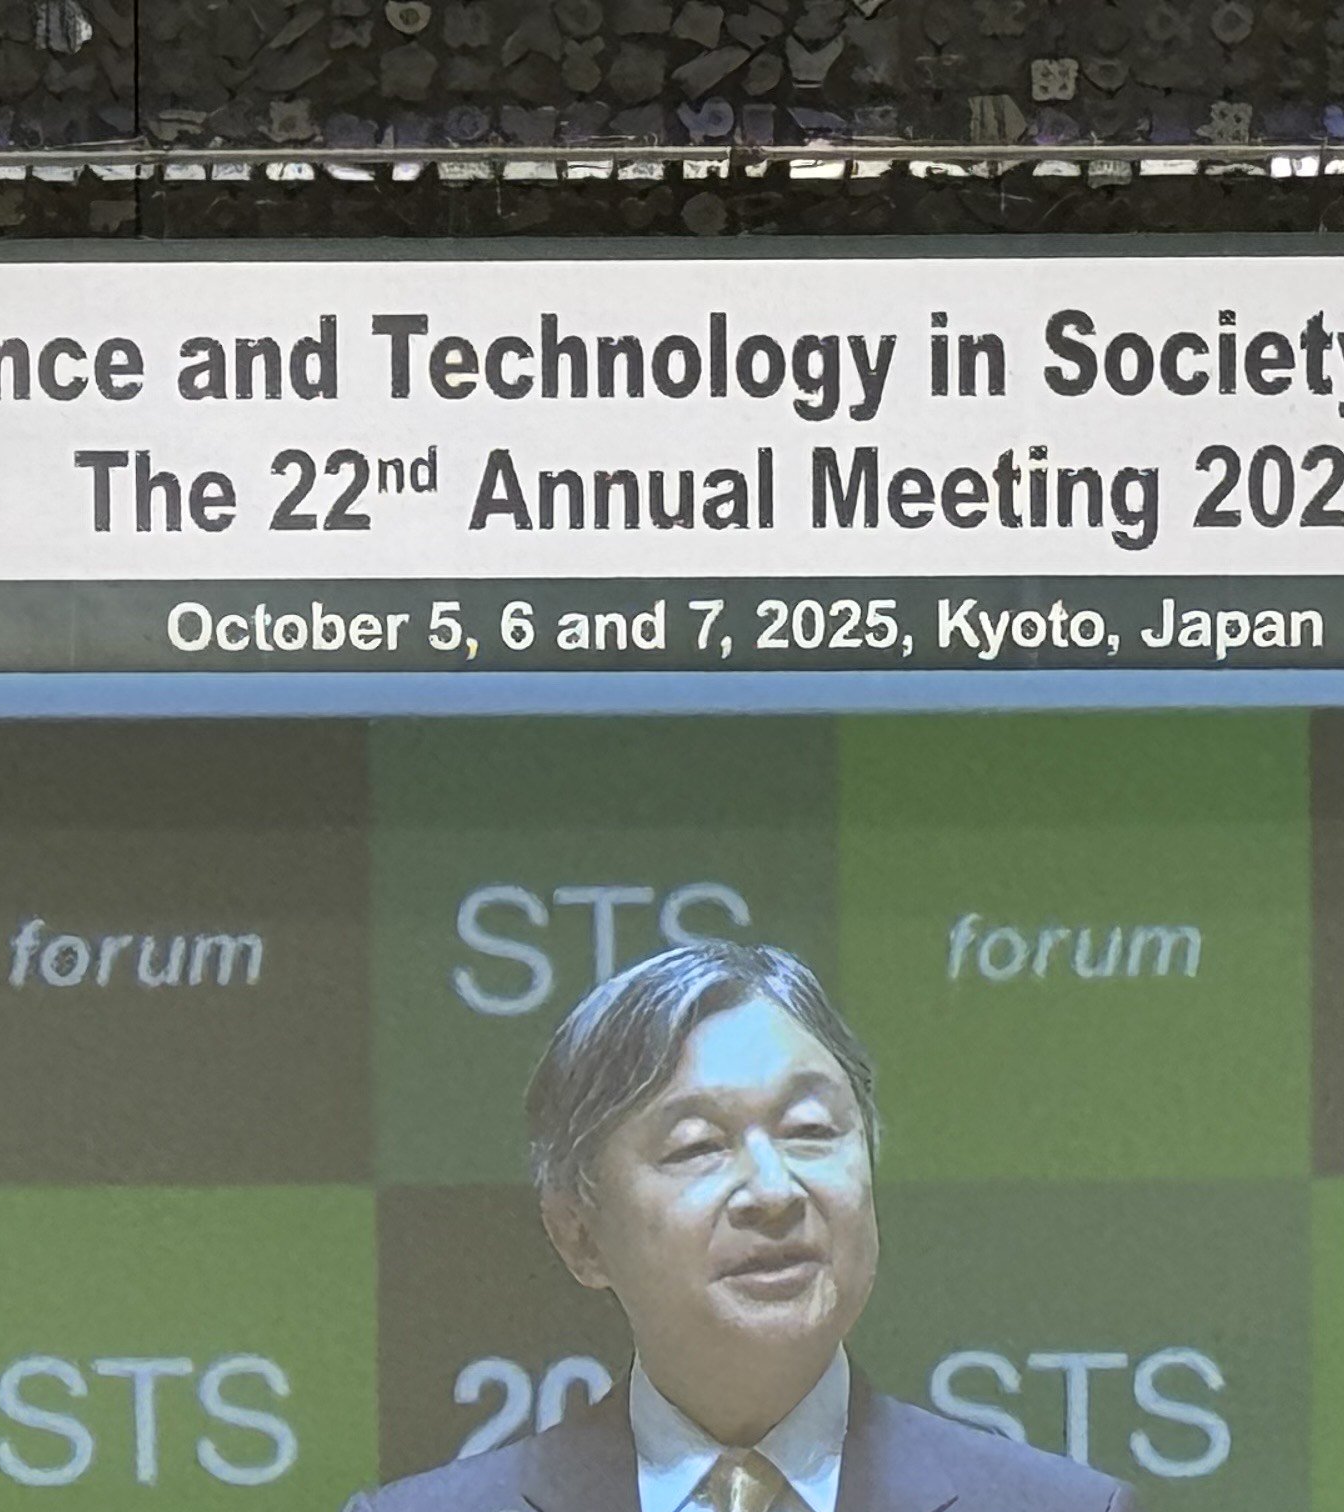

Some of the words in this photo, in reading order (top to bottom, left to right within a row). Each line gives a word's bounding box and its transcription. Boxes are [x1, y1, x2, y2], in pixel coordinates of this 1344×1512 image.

[179, 315, 337, 400] and
[372, 313, 896, 421] Technology
[932, 312, 1005, 396] in
[75, 450, 236, 531] The
[270, 446, 436, 530] 22nd
[470, 447, 773, 530] Annual
[813, 445, 1158, 550] Meeting
[168, 601, 409, 651] October
[429, 602, 477, 659] 5,
[501, 601, 534, 650] 6
[557, 600, 665, 650] and
[689, 600, 731, 658] 7,
[757, 600, 912, 657] 2025,
[939, 599, 1119, 660] Kyoto,
[1141, 599, 1323, 660] Japan
[10, 919, 263, 986] forum
[948, 913, 1202, 981] forum
[930, 1348, 1231, 1476] STS
